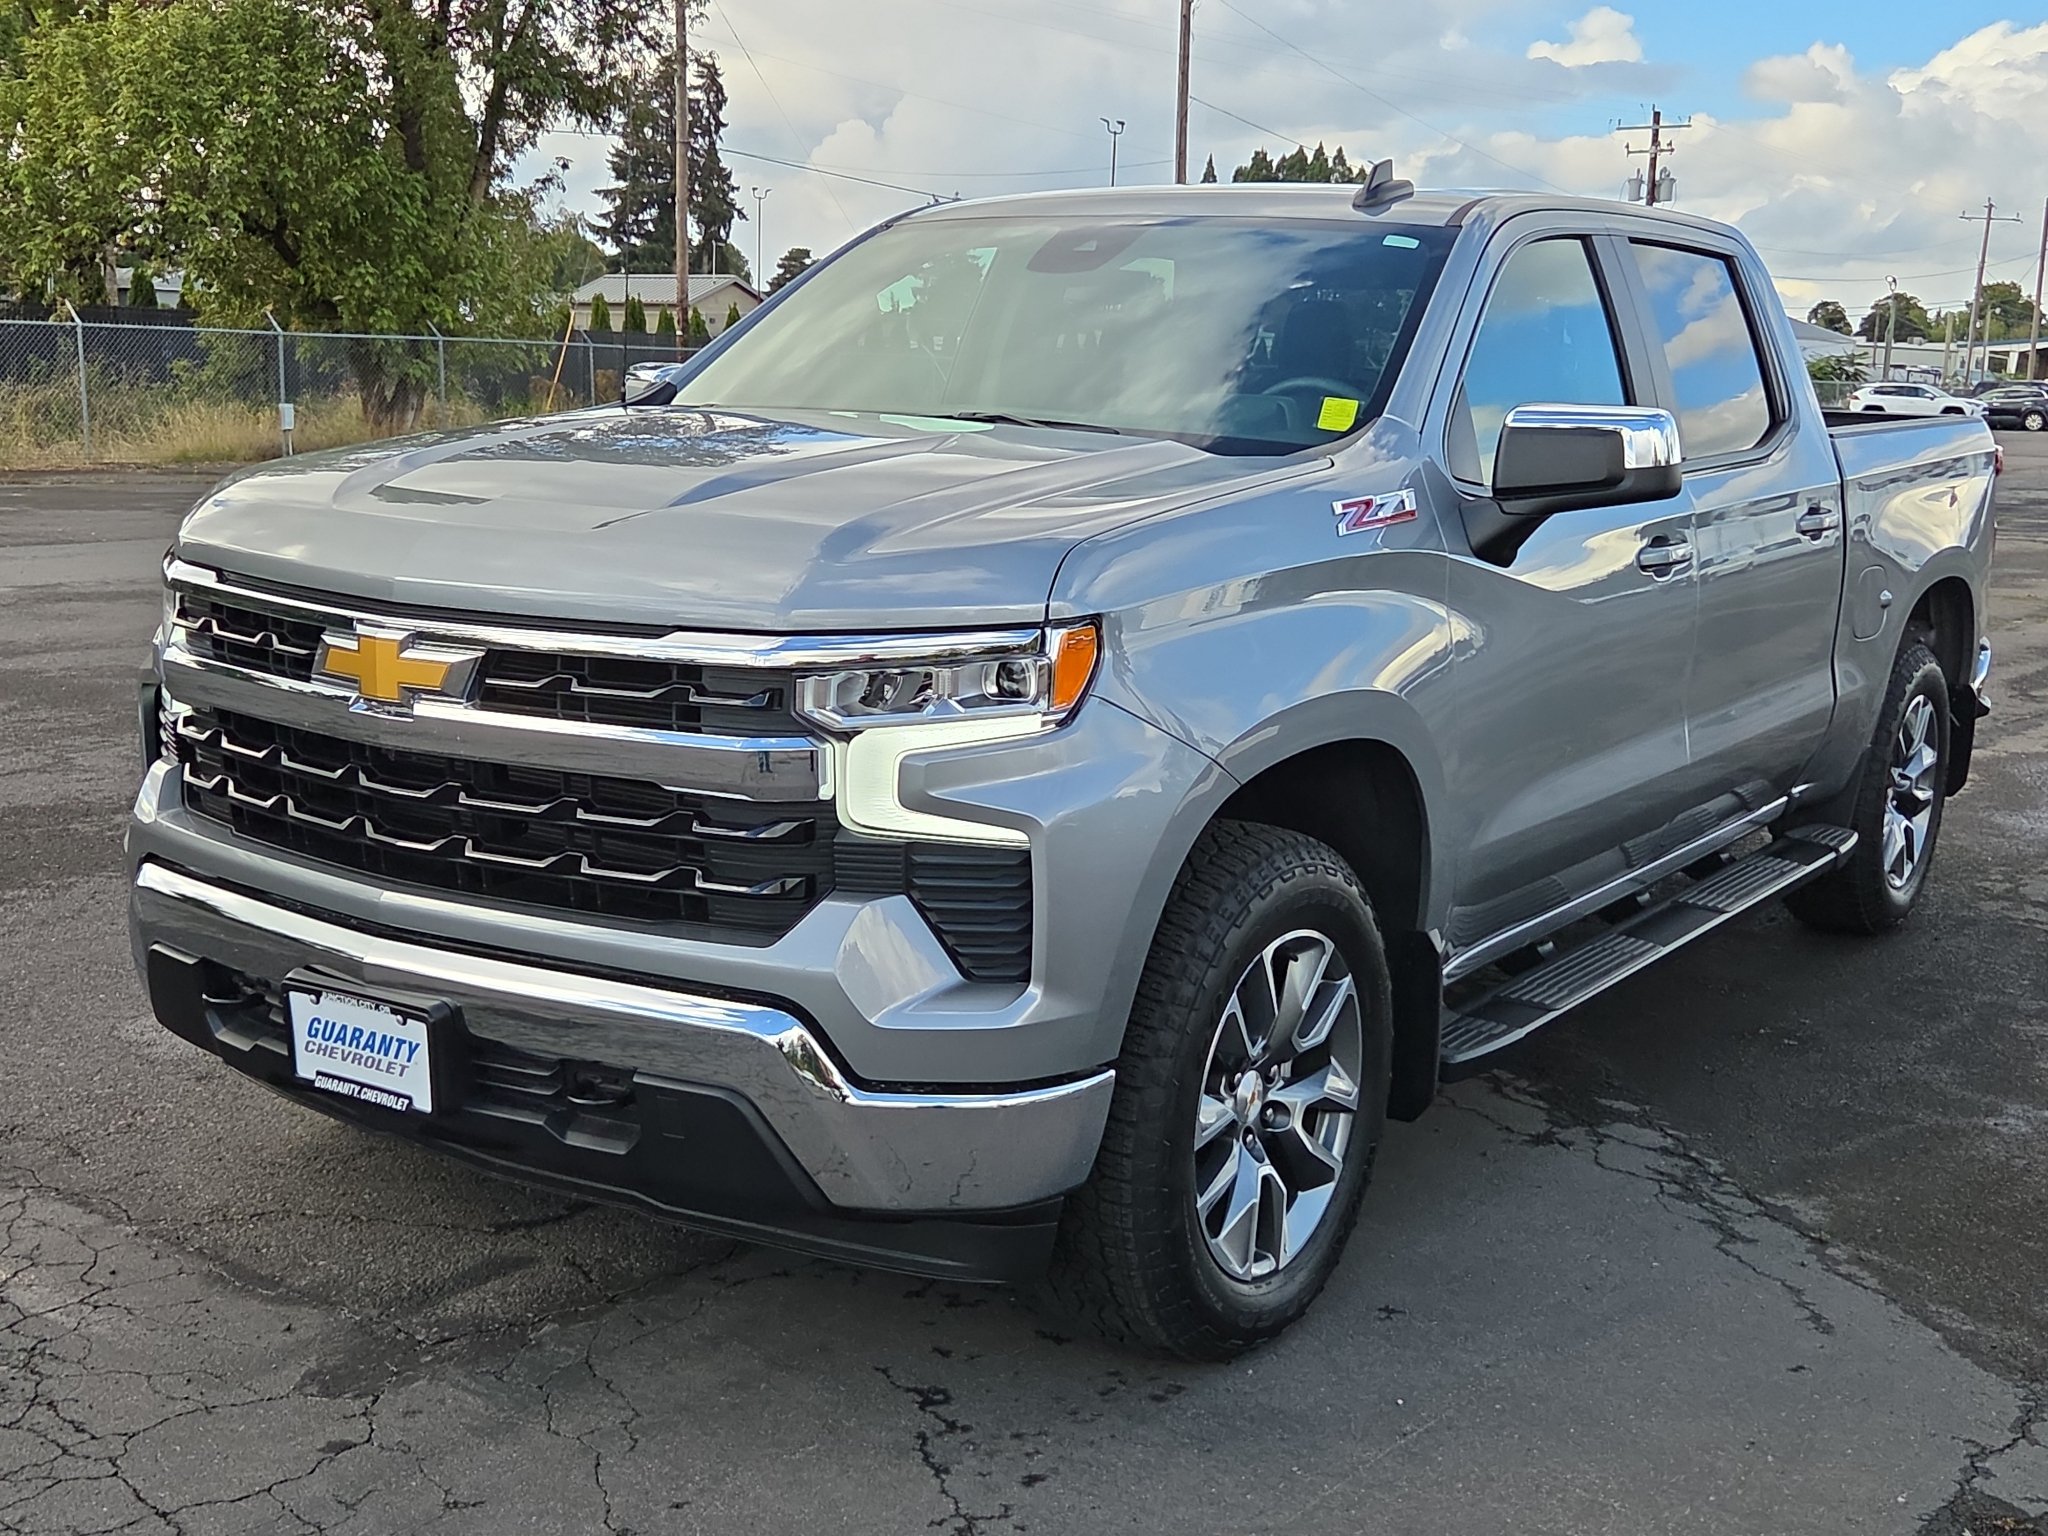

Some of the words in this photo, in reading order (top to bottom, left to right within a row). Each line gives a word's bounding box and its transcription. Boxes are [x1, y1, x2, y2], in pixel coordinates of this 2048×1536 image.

[1332, 488, 1418, 537] Z71
[304, 1040, 409, 1077] CHEVROLET
[307, 1017, 420, 1063] GUARANTY
[360, 1087, 409, 1112] CHEVROLET
